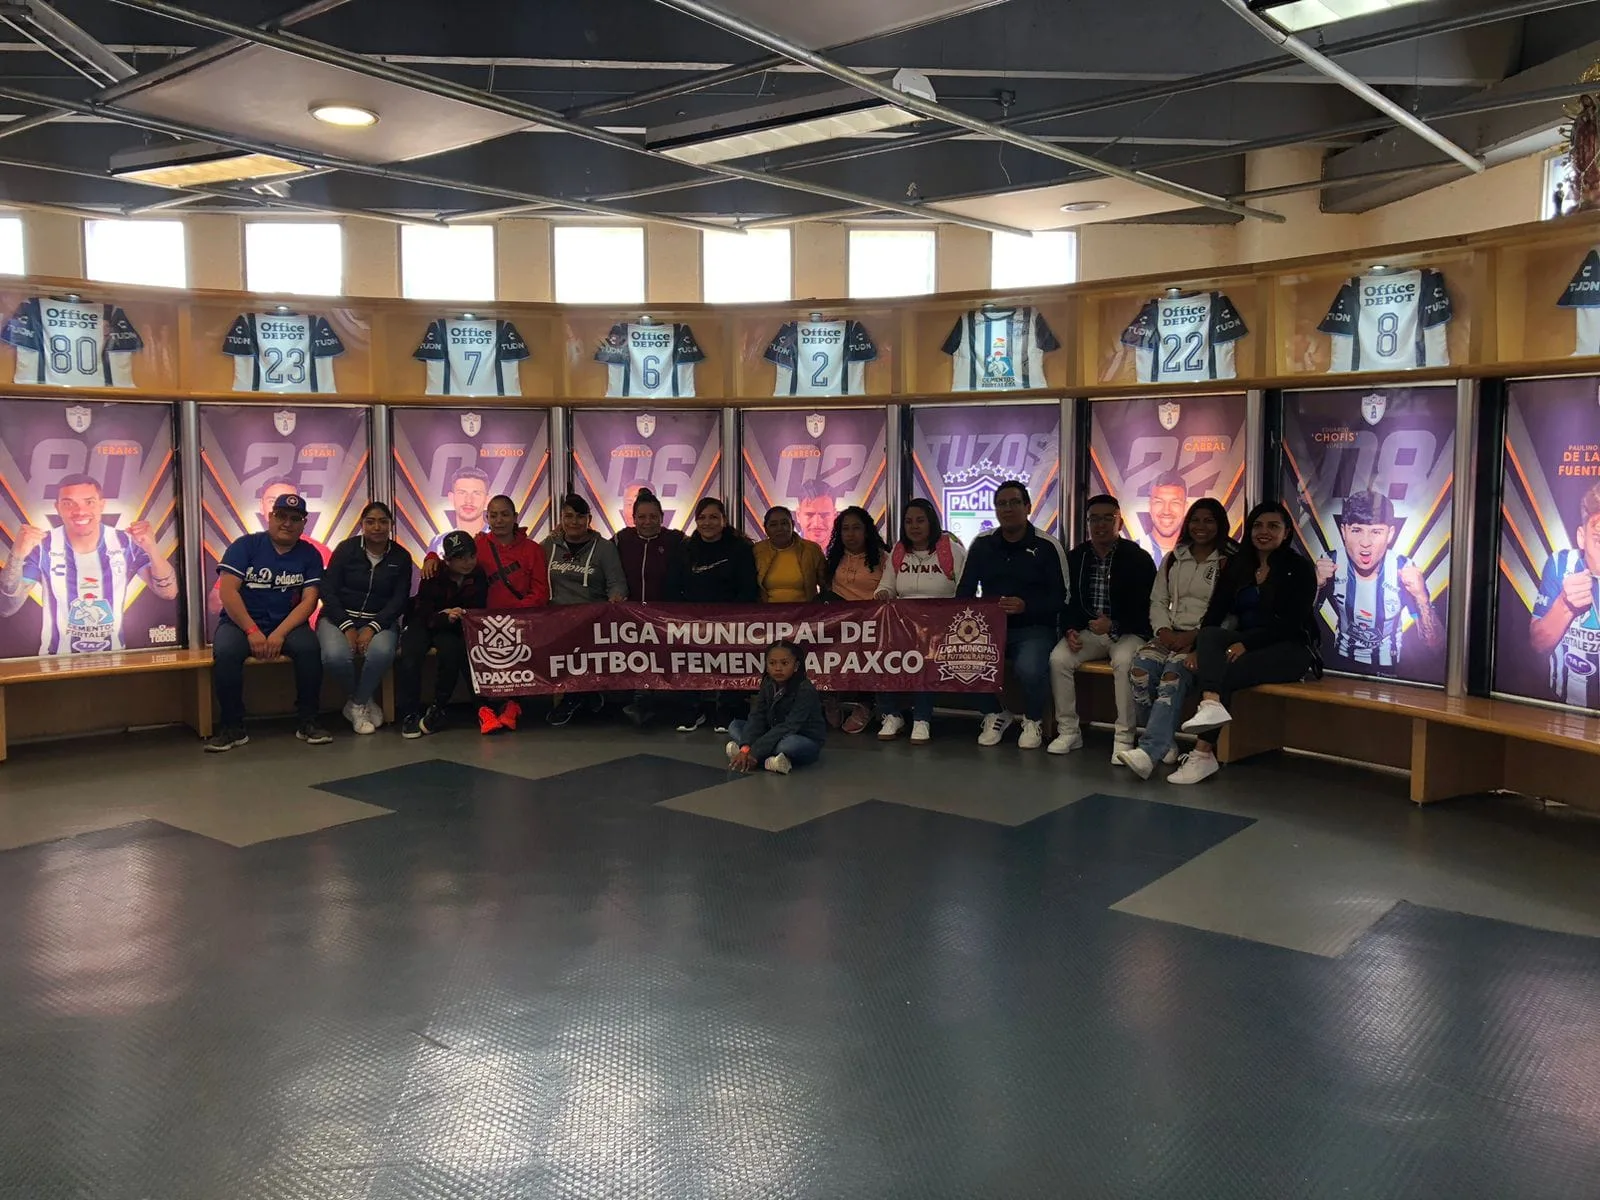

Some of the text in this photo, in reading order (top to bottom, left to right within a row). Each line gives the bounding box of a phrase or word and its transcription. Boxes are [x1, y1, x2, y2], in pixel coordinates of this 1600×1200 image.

[1364, 283, 1415, 297] Office
[1364, 294, 1415, 306] DEPOT
[47, 308, 98, 321] Office
[1163, 306, 1205, 318] Office
[48, 320, 97, 329] DEPOT
[261, 322, 305, 332] Office
[1163, 315, 1206, 326] DEPOT
[262, 332, 304, 340] DEPOT
[451, 327, 492, 337] Office
[631, 332, 670, 340] Office
[801, 328, 841, 336] Office
[1376, 312, 1399, 357] 8
[50, 335, 97, 375] 80
[1163, 331, 1203, 373] 22
[264, 347, 306, 384] 23
[464, 351, 482, 386] 7
[643, 355, 660, 389] 6
[811, 351, 829, 386] 2
[1184, 441, 1226, 451] CABRAL
[918, 433, 1053, 478] TUZOS
[1563, 451, 1600, 462] DE LA
[1125, 436, 1232, 497] 22
[951, 489, 997, 511] PACHU
[593, 620, 877, 646] LIGA MUNICIPAL DE
[939, 644, 996, 654] LIGA MUNICIPAL
[549, 647, 924, 678] FÚTBOL FEMEN APAXCO
